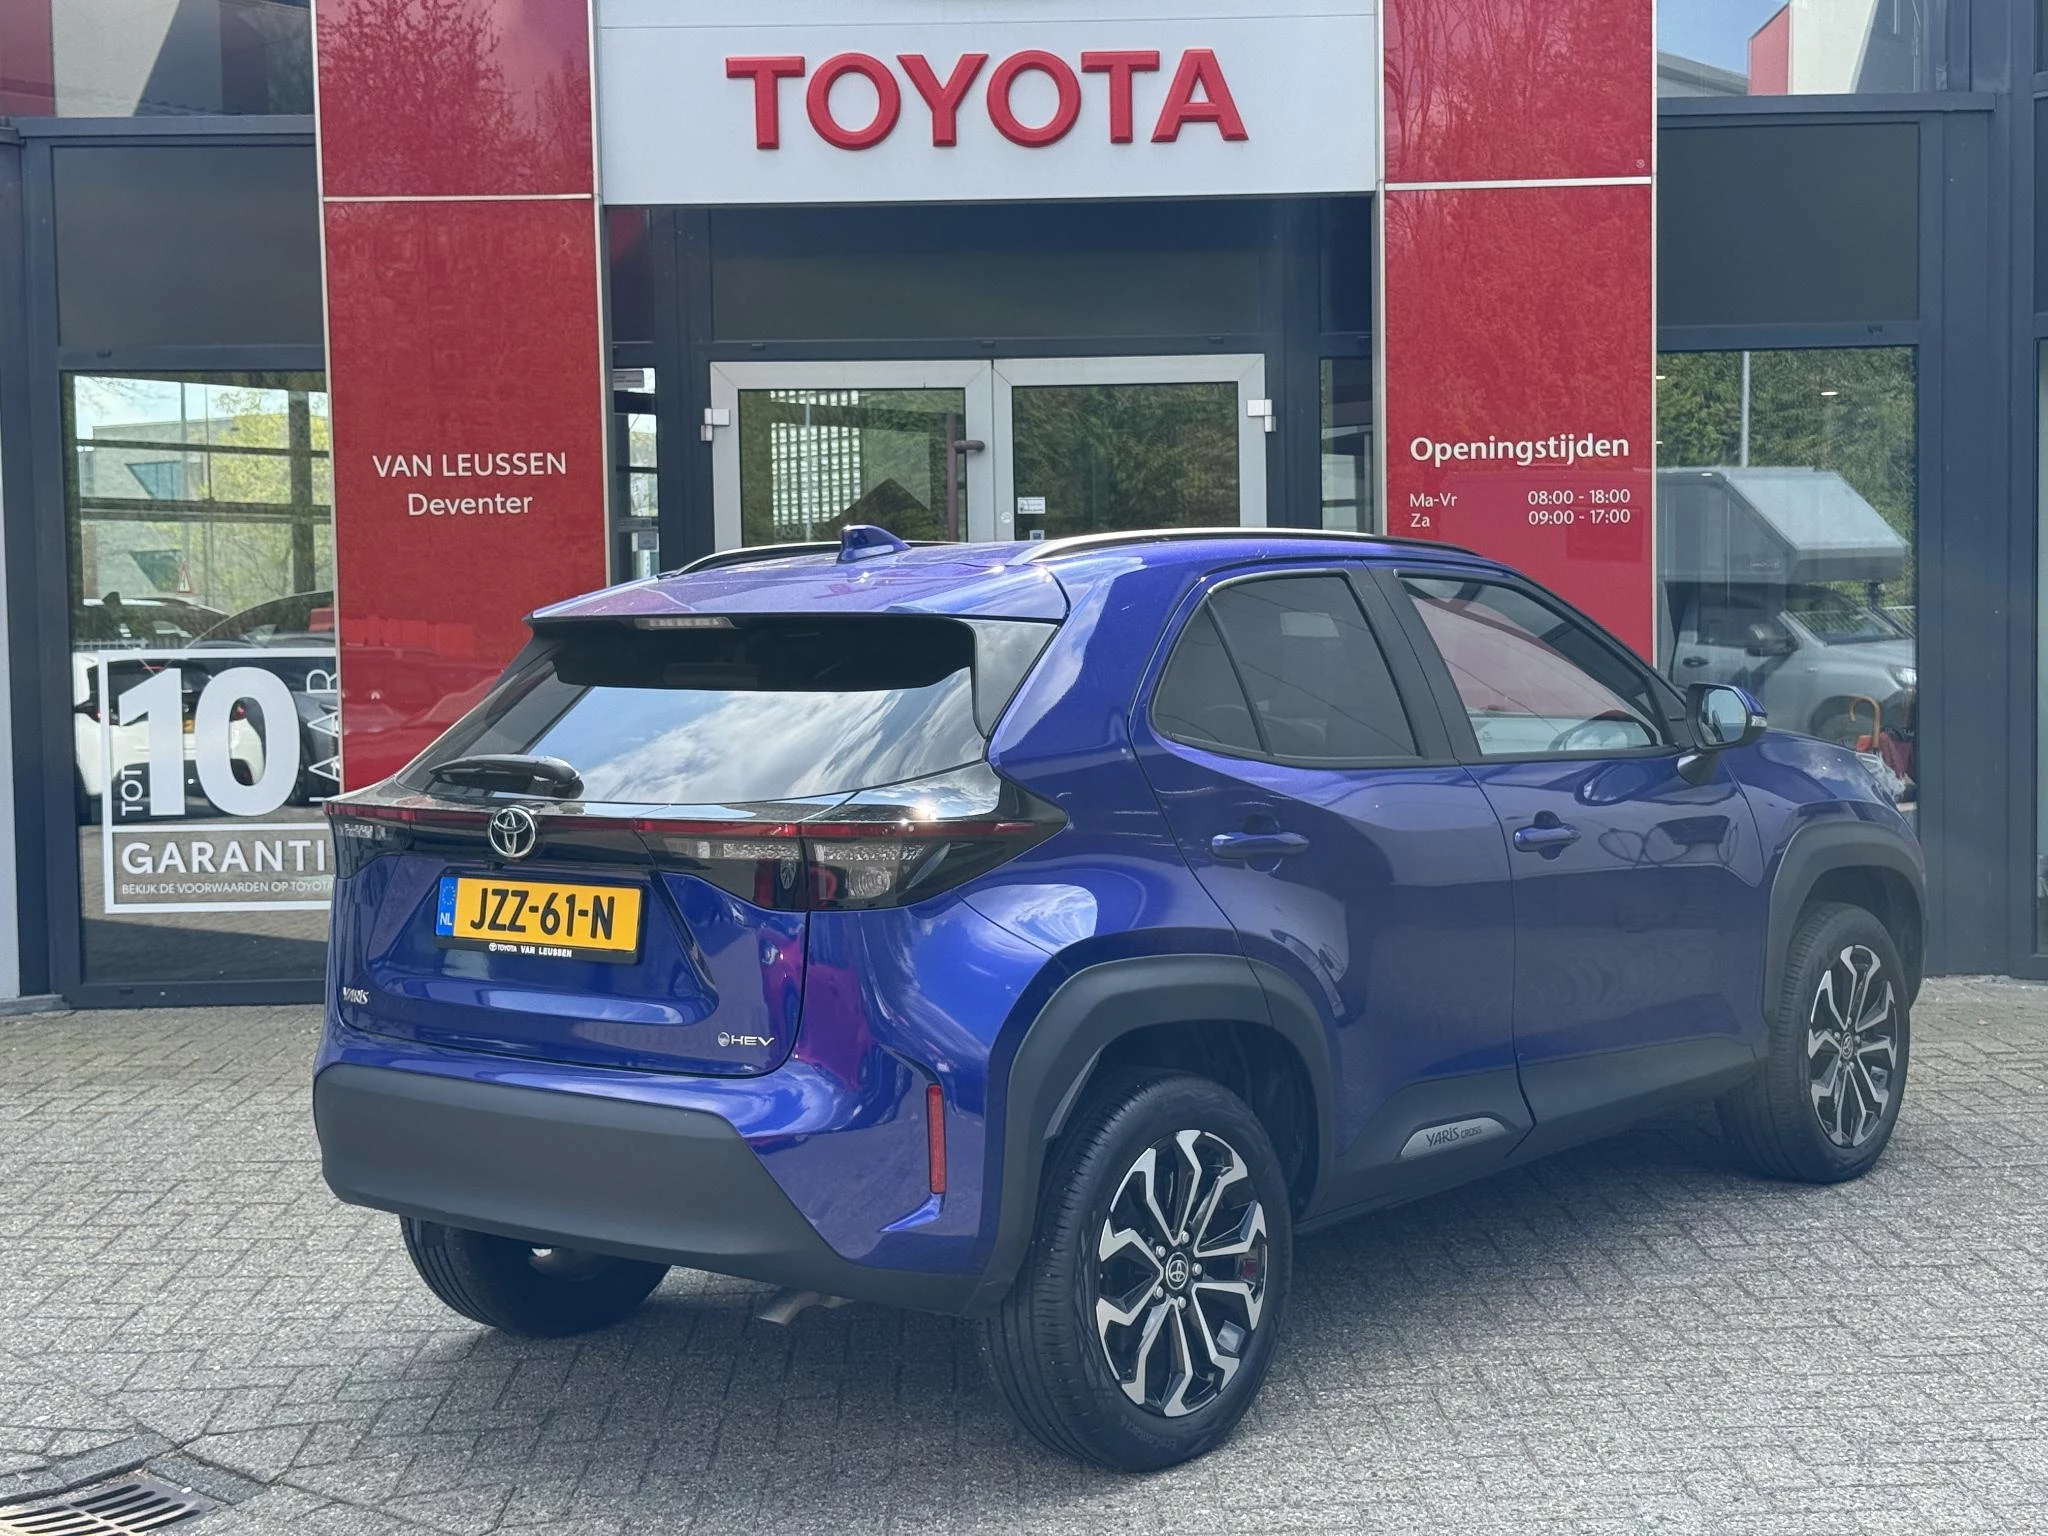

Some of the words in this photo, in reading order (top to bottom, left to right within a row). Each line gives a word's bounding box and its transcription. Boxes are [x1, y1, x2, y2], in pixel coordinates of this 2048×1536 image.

[725, 48, 1248, 151] TOYOTA
[1410, 432, 1630, 468] Openingstijden
[371, 454, 432, 478] VAN
[442, 451, 567, 477] LEUSSEN
[407, 492, 533, 516] Deventer
[1409, 492, 1458, 508] Ma-Vr
[1527, 490, 1574, 506] 08:00
[1589, 488, 1631, 505] 18:00
[1410, 513, 1431, 528] Za
[1528, 509, 1575, 526] 09:00
[1590, 508, 1631, 525] 17:00
[118, 666, 301, 817] 10
[121, 768, 143, 817] TOT
[122, 883, 157, 895] BEKIJK
[160, 883, 175, 894] DE
[177, 881, 269, 894] VOORWAARDEN
[271, 881, 289, 892] OP
[440, 911, 453, 927] NL
[469, 886, 616, 941] JZZ-61-N
[497, 943, 518, 953] TOYOTA
[520, 945, 536, 955] VAN
[538, 946, 573, 958] LEUSSEN
[731, 1034, 775, 1047] HEV
[1426, 1127, 1460, 1147] YARIS
[1460, 1126, 1482, 1138] CROSS
